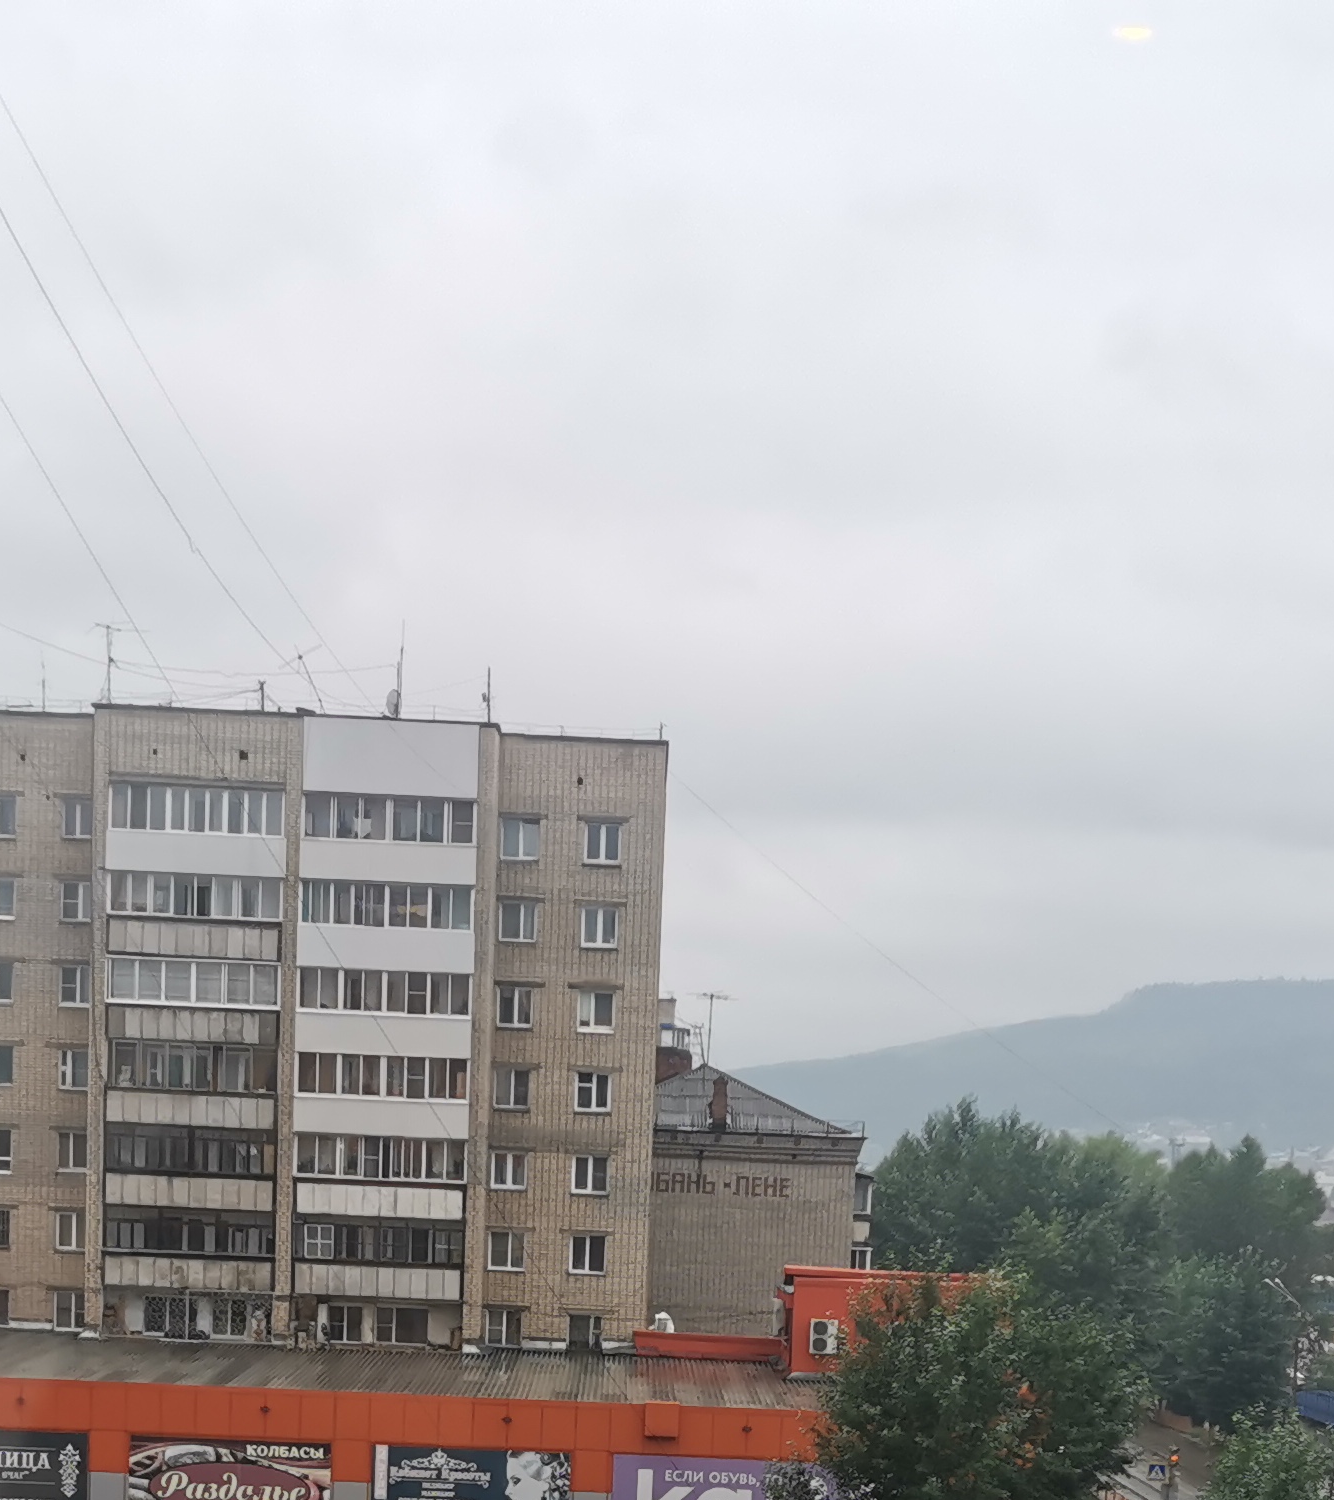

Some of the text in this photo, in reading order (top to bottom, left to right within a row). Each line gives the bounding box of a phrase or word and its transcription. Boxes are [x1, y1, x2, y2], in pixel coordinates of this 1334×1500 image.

[651, 1171, 791, 1197] БАНЬ ЛЕНЕ
[246, 1444, 325, 1460] КОЛБАСЫ
[665, 1470, 704, 1484] ЕСЛИ
[709, 1472, 761, 1488] ОБУВЬ,
